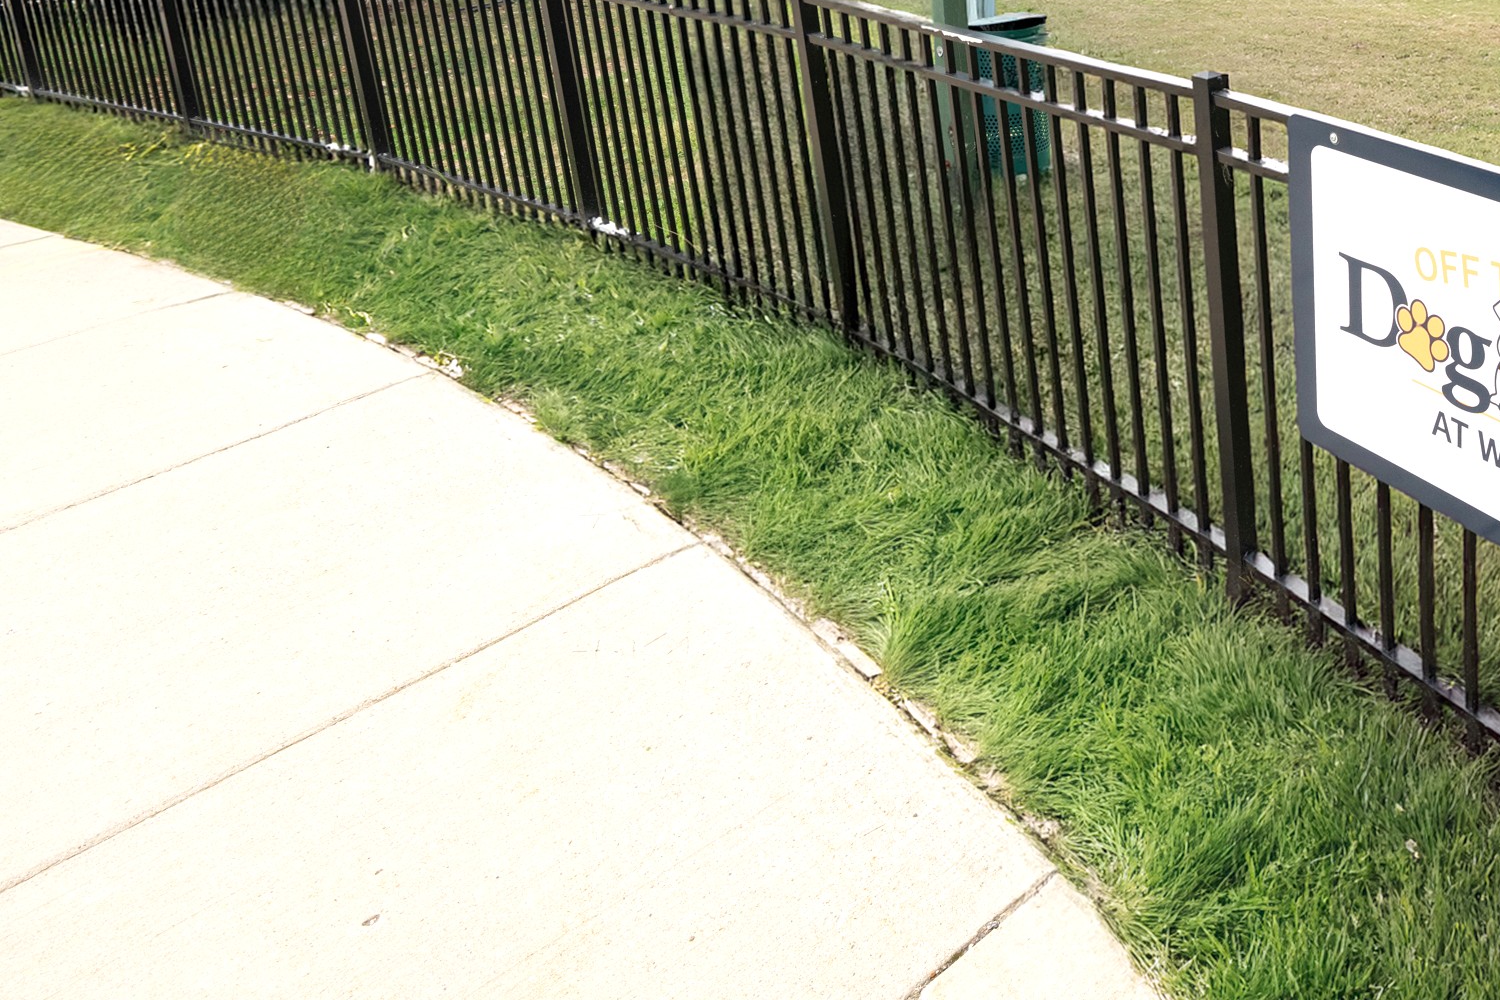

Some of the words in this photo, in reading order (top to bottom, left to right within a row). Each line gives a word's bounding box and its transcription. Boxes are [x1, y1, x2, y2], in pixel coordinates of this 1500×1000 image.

[1415, 247, 1479, 288] OFF
[1338, 251, 1492, 414] Dg
[1431, 411, 1469, 449] AT
